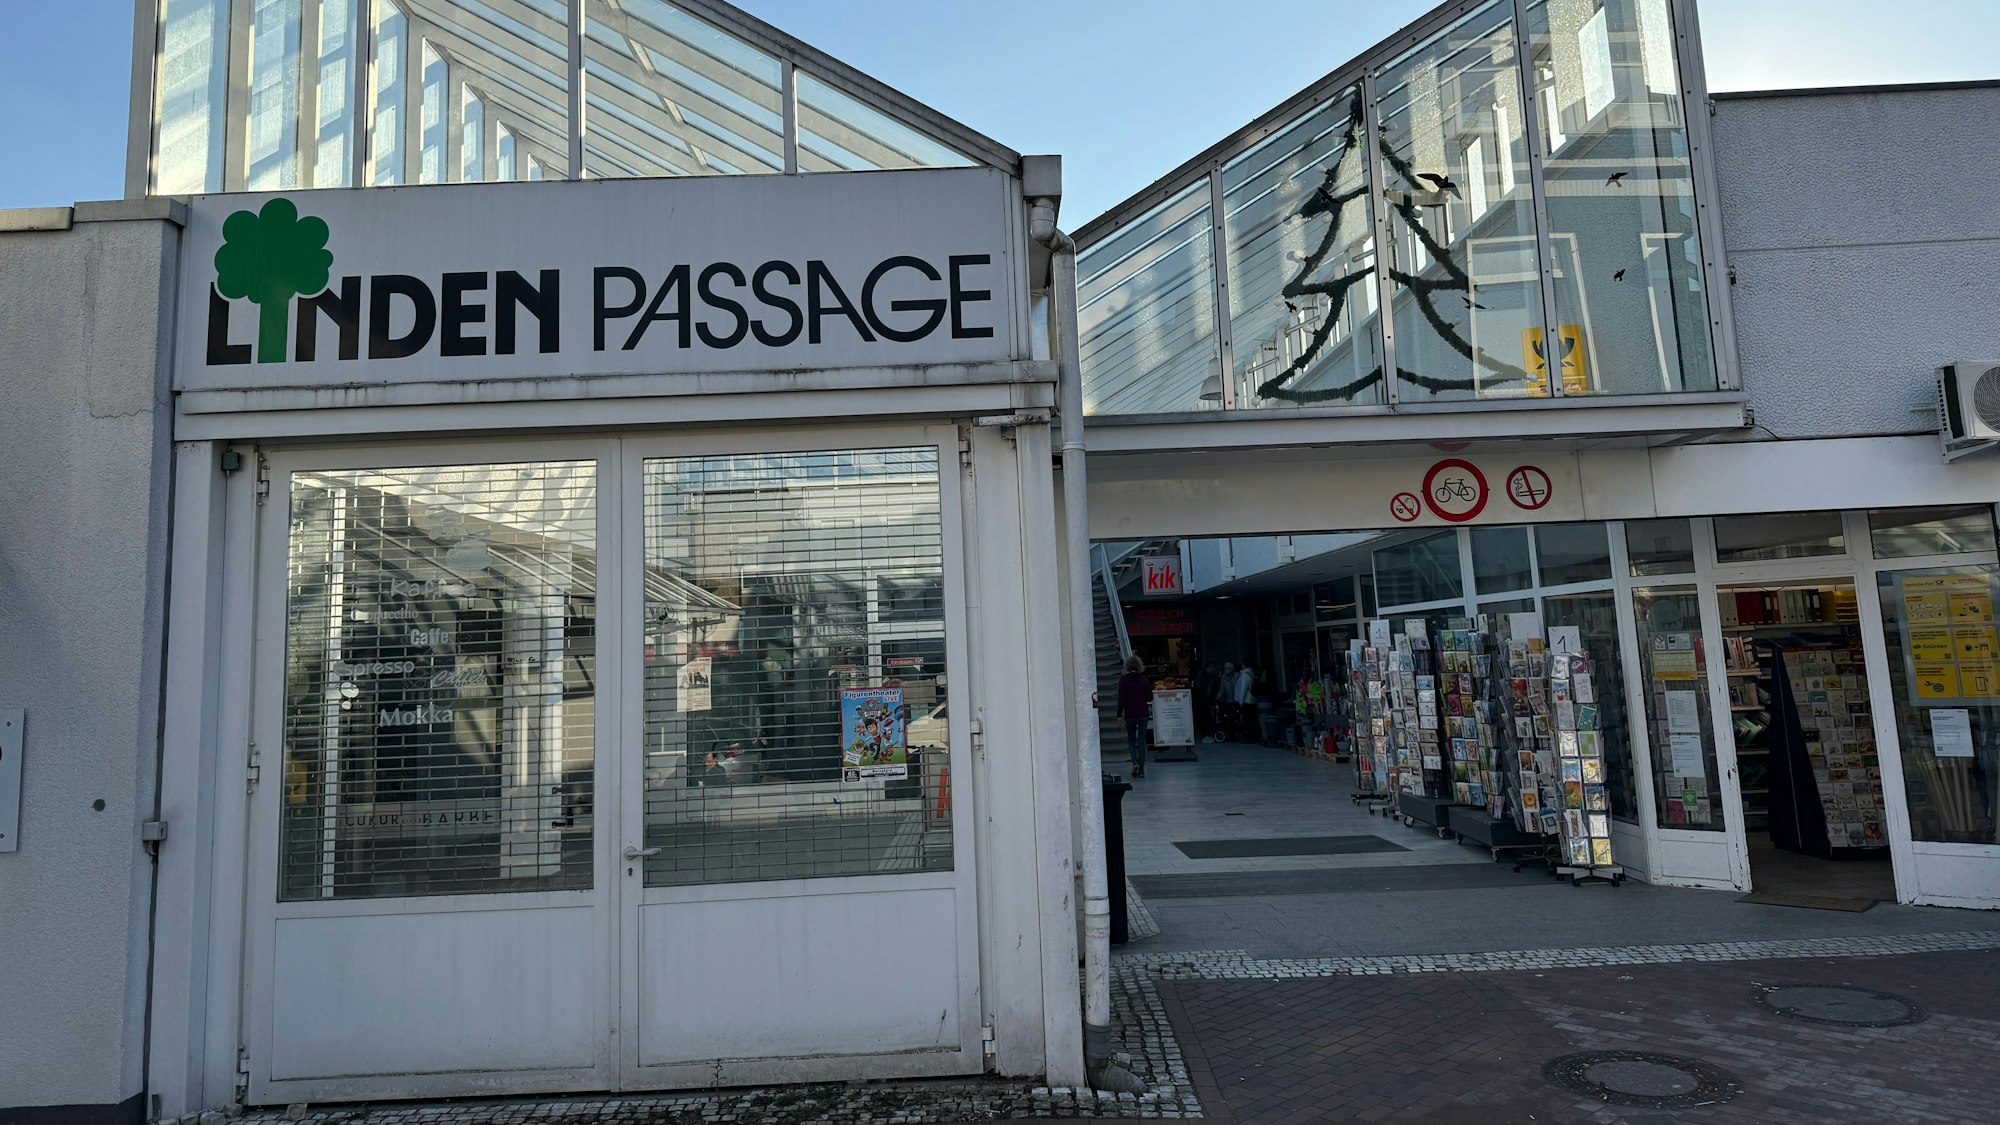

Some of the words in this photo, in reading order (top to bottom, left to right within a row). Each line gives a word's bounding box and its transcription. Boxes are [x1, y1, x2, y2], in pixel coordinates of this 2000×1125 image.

[205, 268, 560, 365] LINDEN
[592, 253, 995, 350] PASSAGE
[1148, 561, 1176, 589] kik
[390, 577, 478, 598] Kaffe
[351, 607, 419, 624] Cppuccino
[410, 628, 449, 645] Caffe
[845, 689, 900, 699] Figurentheater
[379, 704, 454, 727] Mokka
